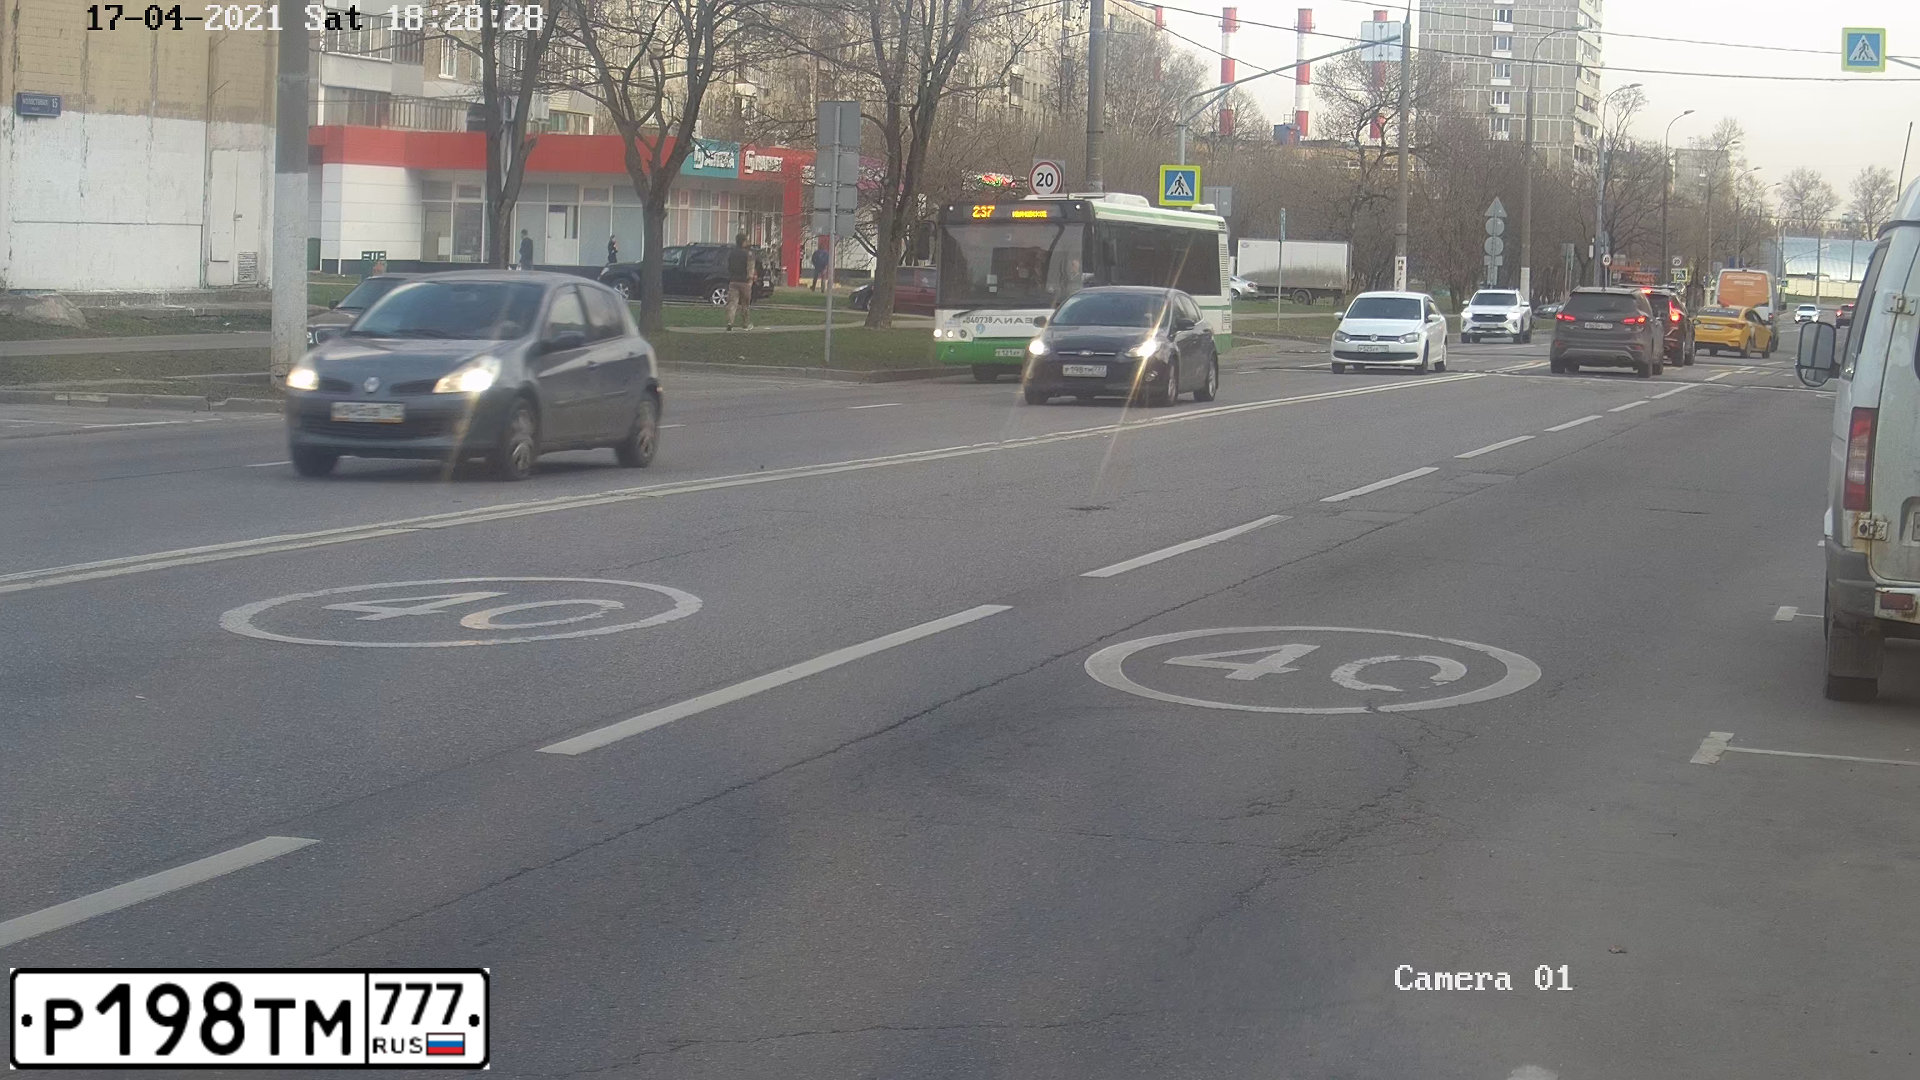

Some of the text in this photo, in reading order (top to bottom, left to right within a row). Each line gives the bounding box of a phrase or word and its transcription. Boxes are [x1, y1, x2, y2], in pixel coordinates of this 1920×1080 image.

[1035, 172, 1054, 187] 20
[972, 205, 996, 218] 237
[322, 591, 625, 631] 40
